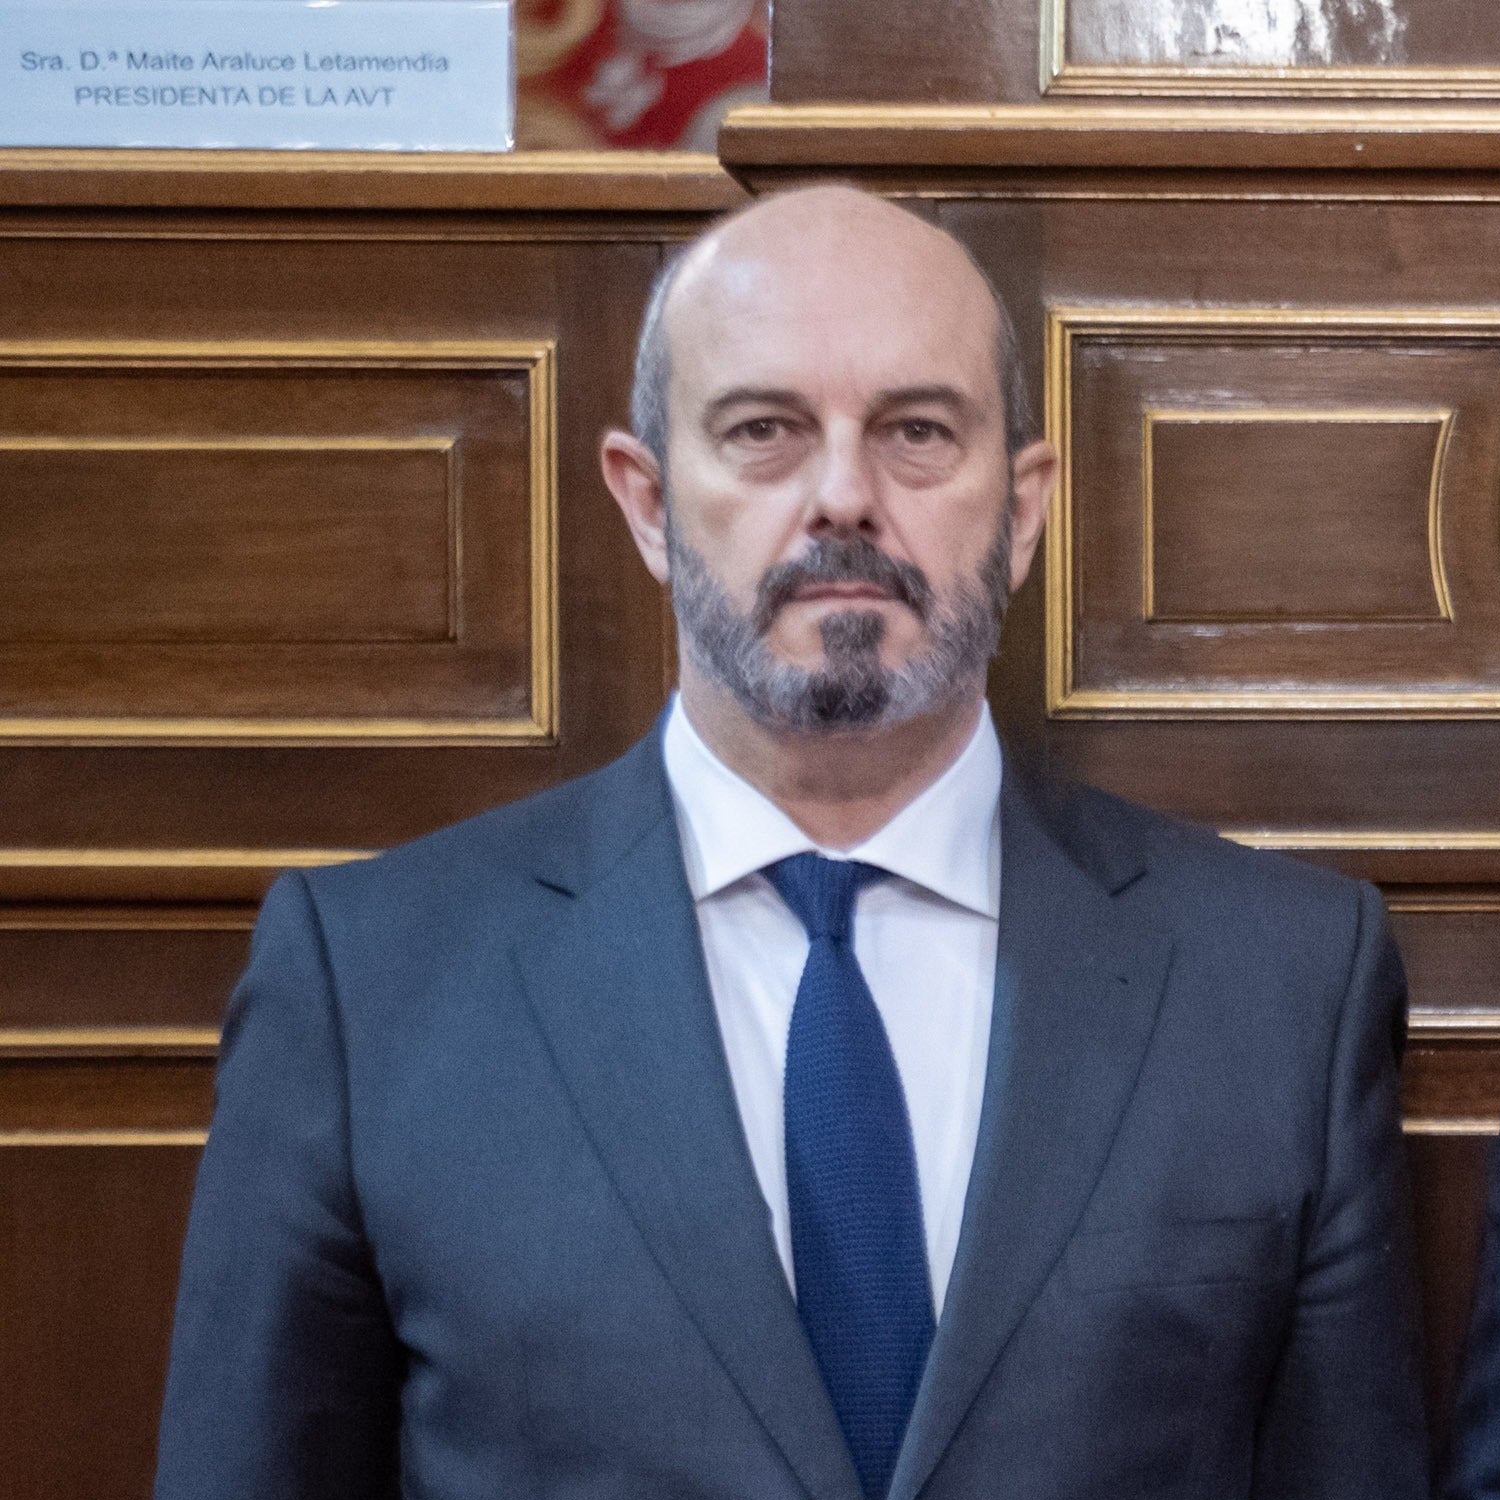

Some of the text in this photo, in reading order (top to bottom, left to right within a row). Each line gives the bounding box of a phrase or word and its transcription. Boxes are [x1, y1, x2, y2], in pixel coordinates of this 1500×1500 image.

[20, 50, 70, 71] Sra.
[126, 50, 194, 71] Maite
[202, 50, 295, 72] Araluce
[73, 86, 394, 106] PRESIDENTA DE LA AVT
